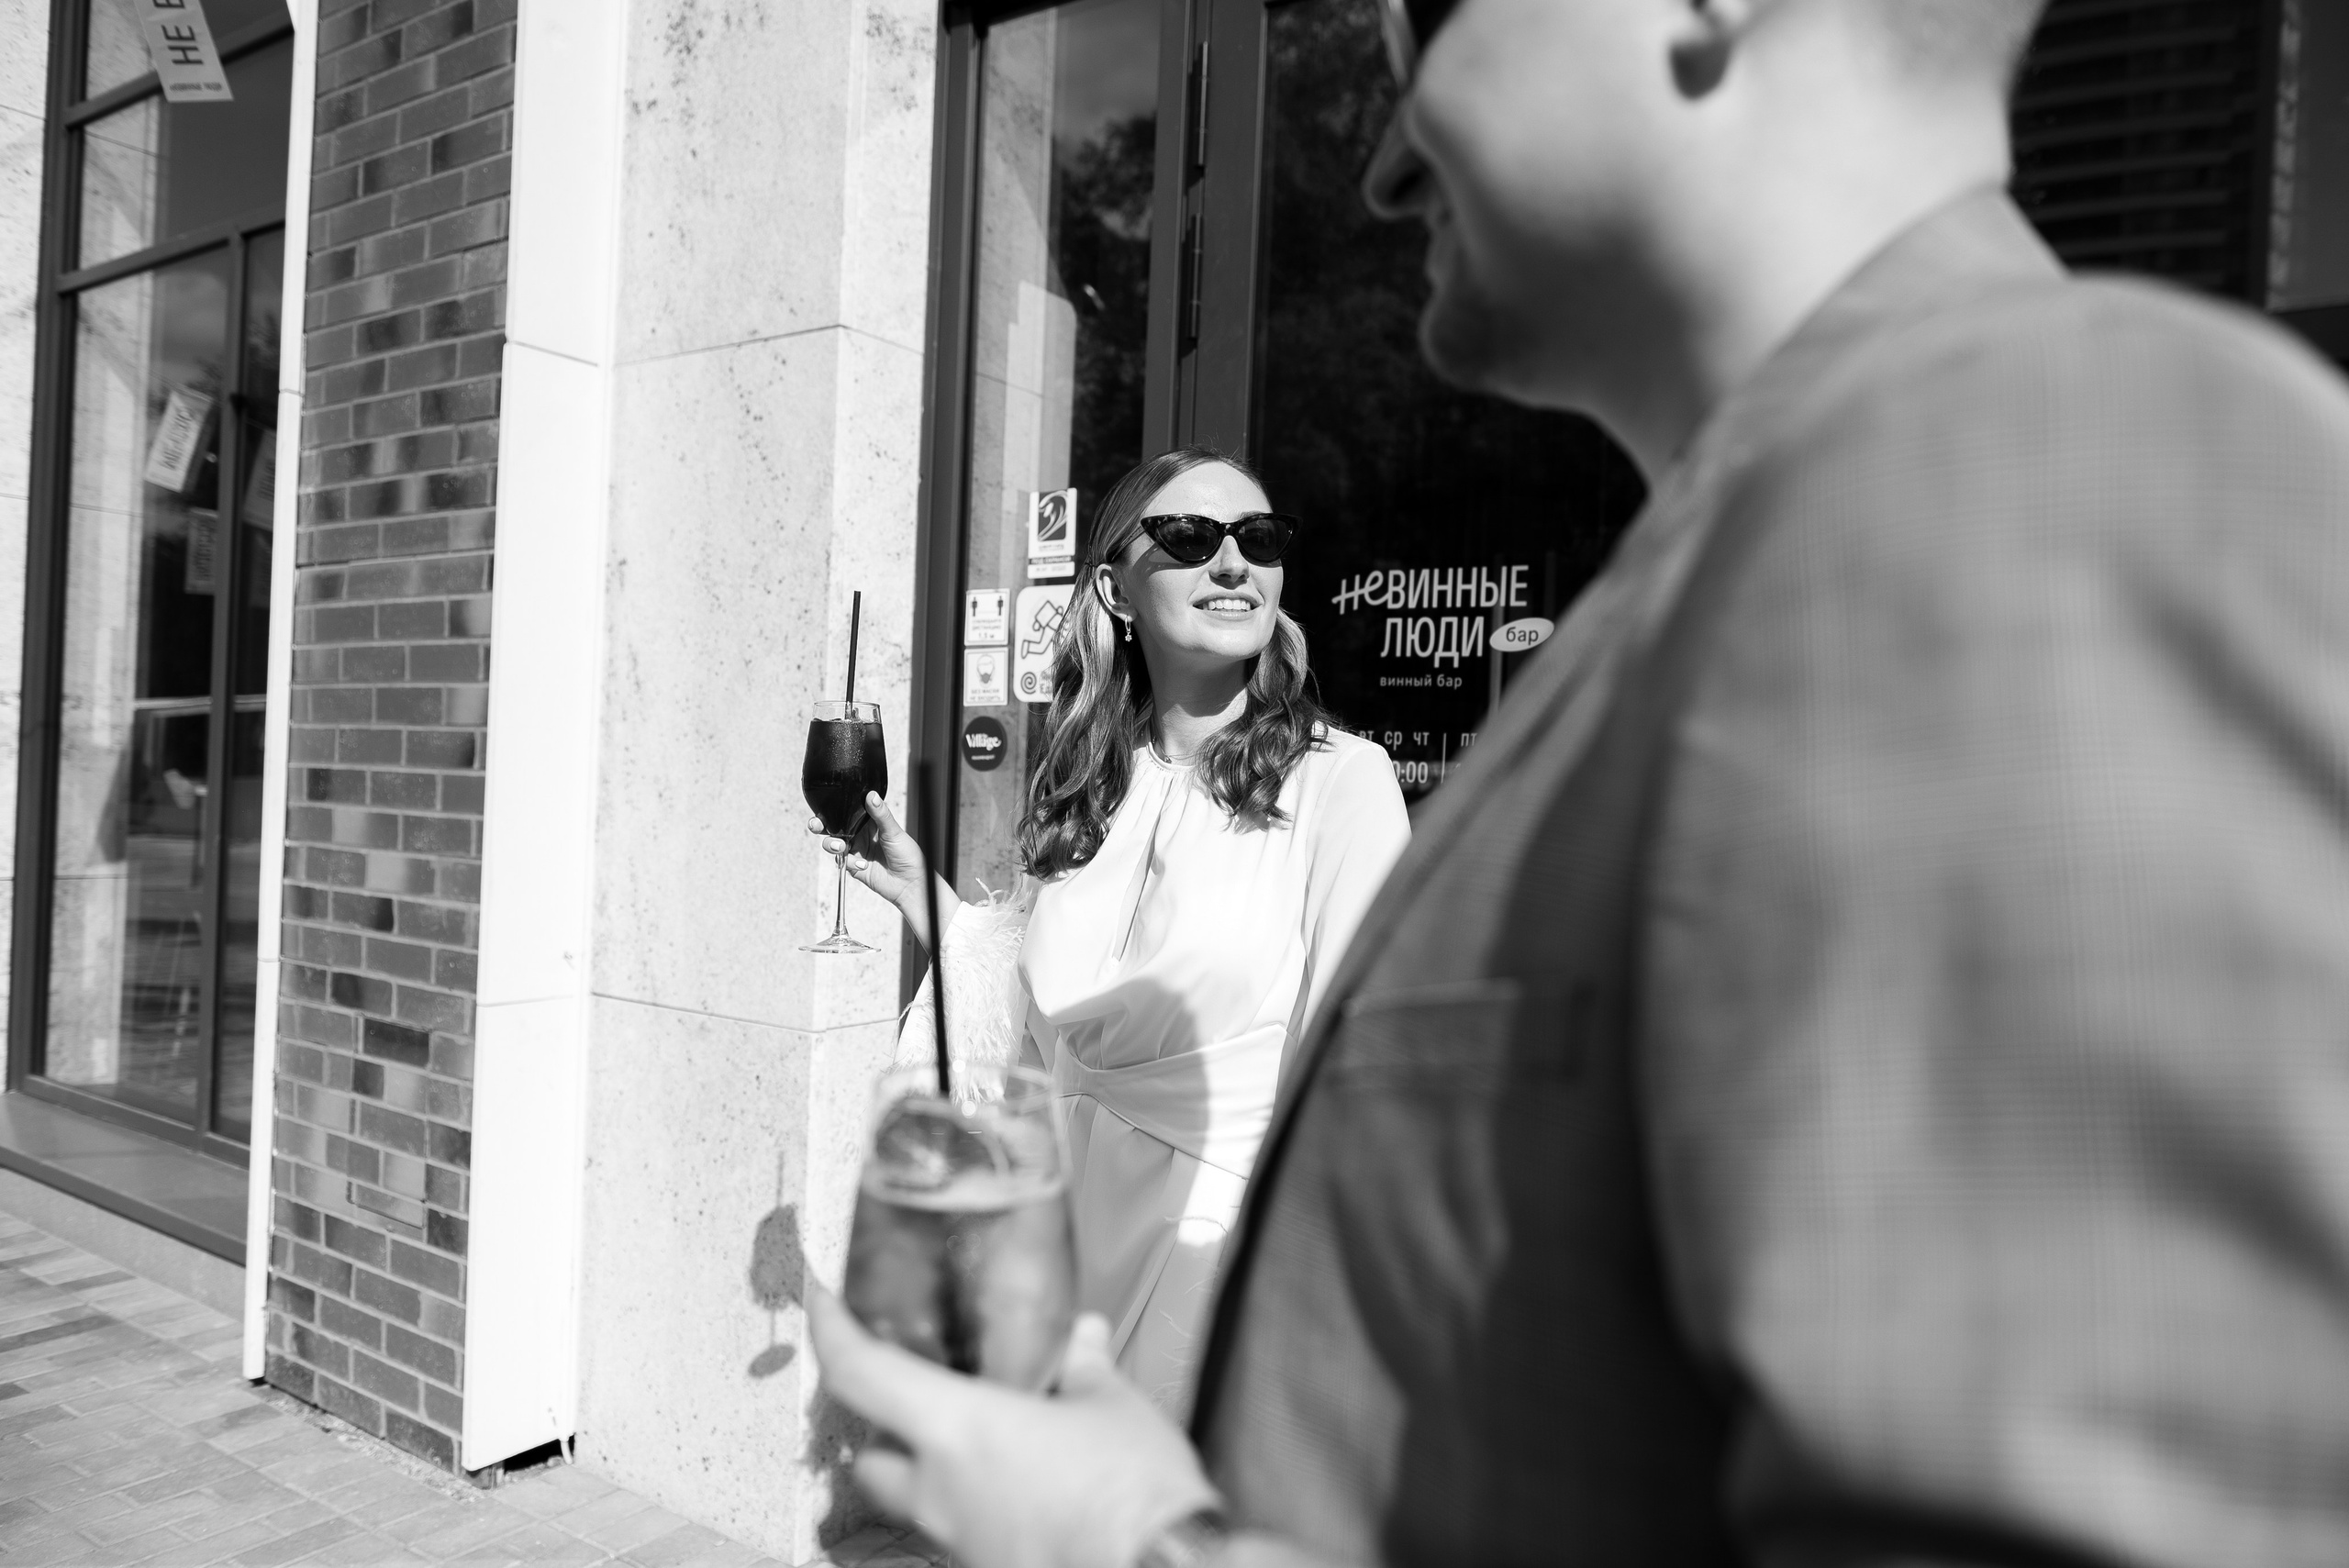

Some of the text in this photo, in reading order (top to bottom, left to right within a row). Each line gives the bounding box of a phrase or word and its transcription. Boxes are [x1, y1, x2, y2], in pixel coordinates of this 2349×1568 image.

[1380, 617, 1485, 668] ЛЮДИ
[1506, 627, 1540, 646] бар
[1379, 674, 1463, 690] винный бар
[965, 733, 1002, 751] Village
[1384, 730, 1403, 751] ср
[1413, 731, 1430, 746] чт
